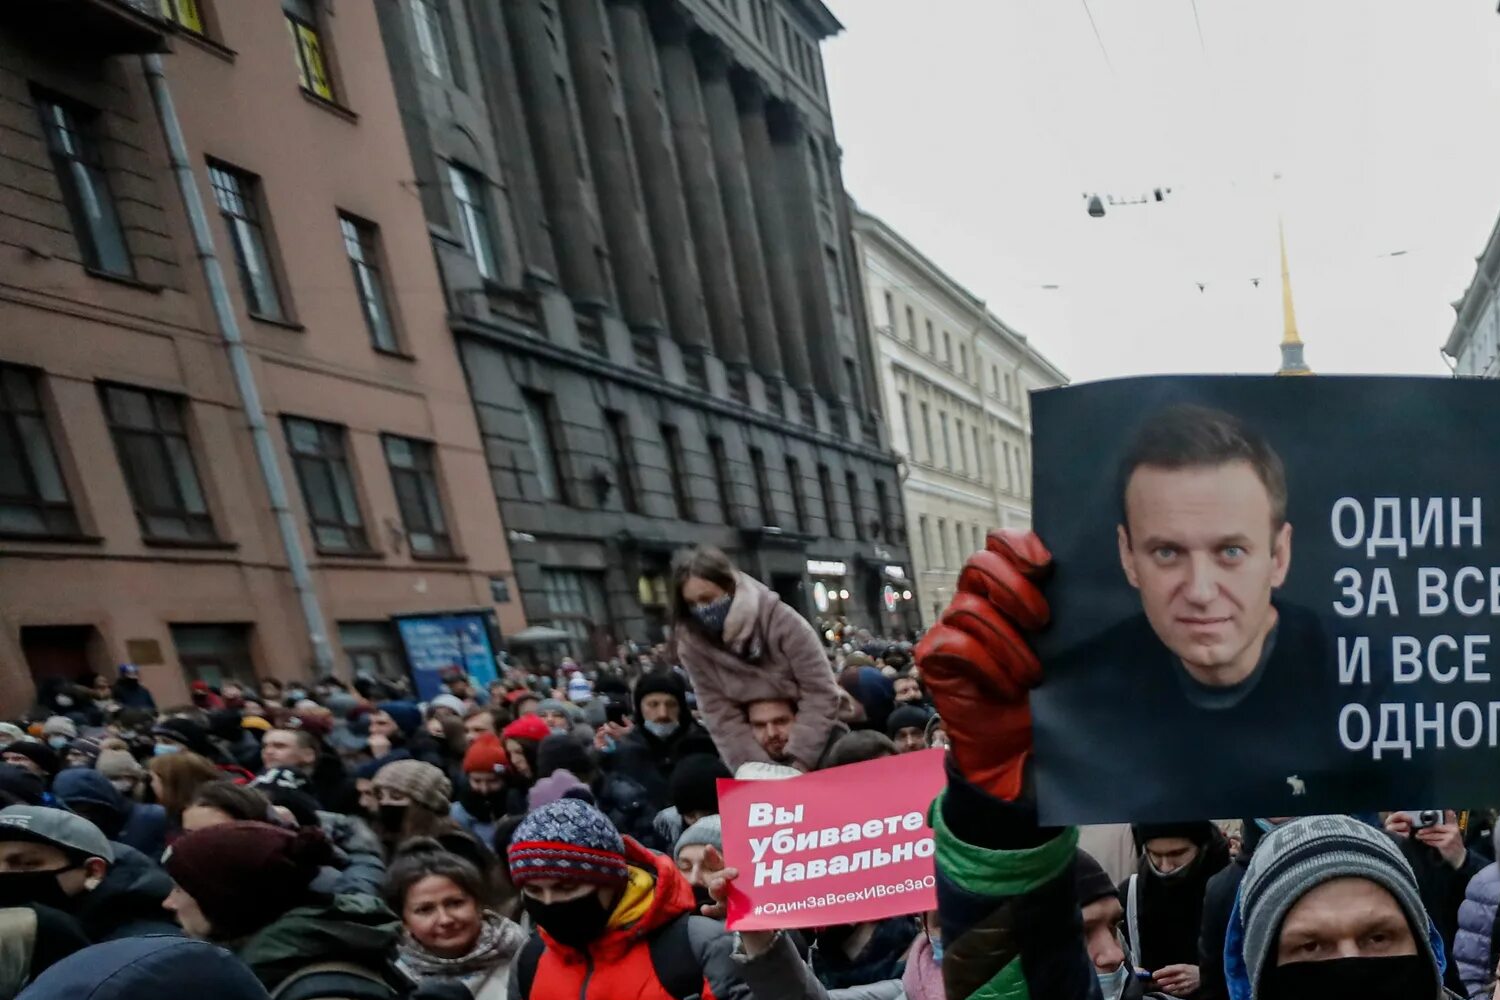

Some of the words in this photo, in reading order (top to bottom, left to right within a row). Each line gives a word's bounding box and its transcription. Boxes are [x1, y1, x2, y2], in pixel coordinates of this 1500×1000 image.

[1331, 497, 1482, 559] ОДИН
[1332, 567, 1399, 617] ЗА
[1337, 636, 1370, 684] И
[1392, 634, 1491, 683] ВСЕ
[748, 803, 804, 827] Вы
[749, 811, 924, 863] убиваете
